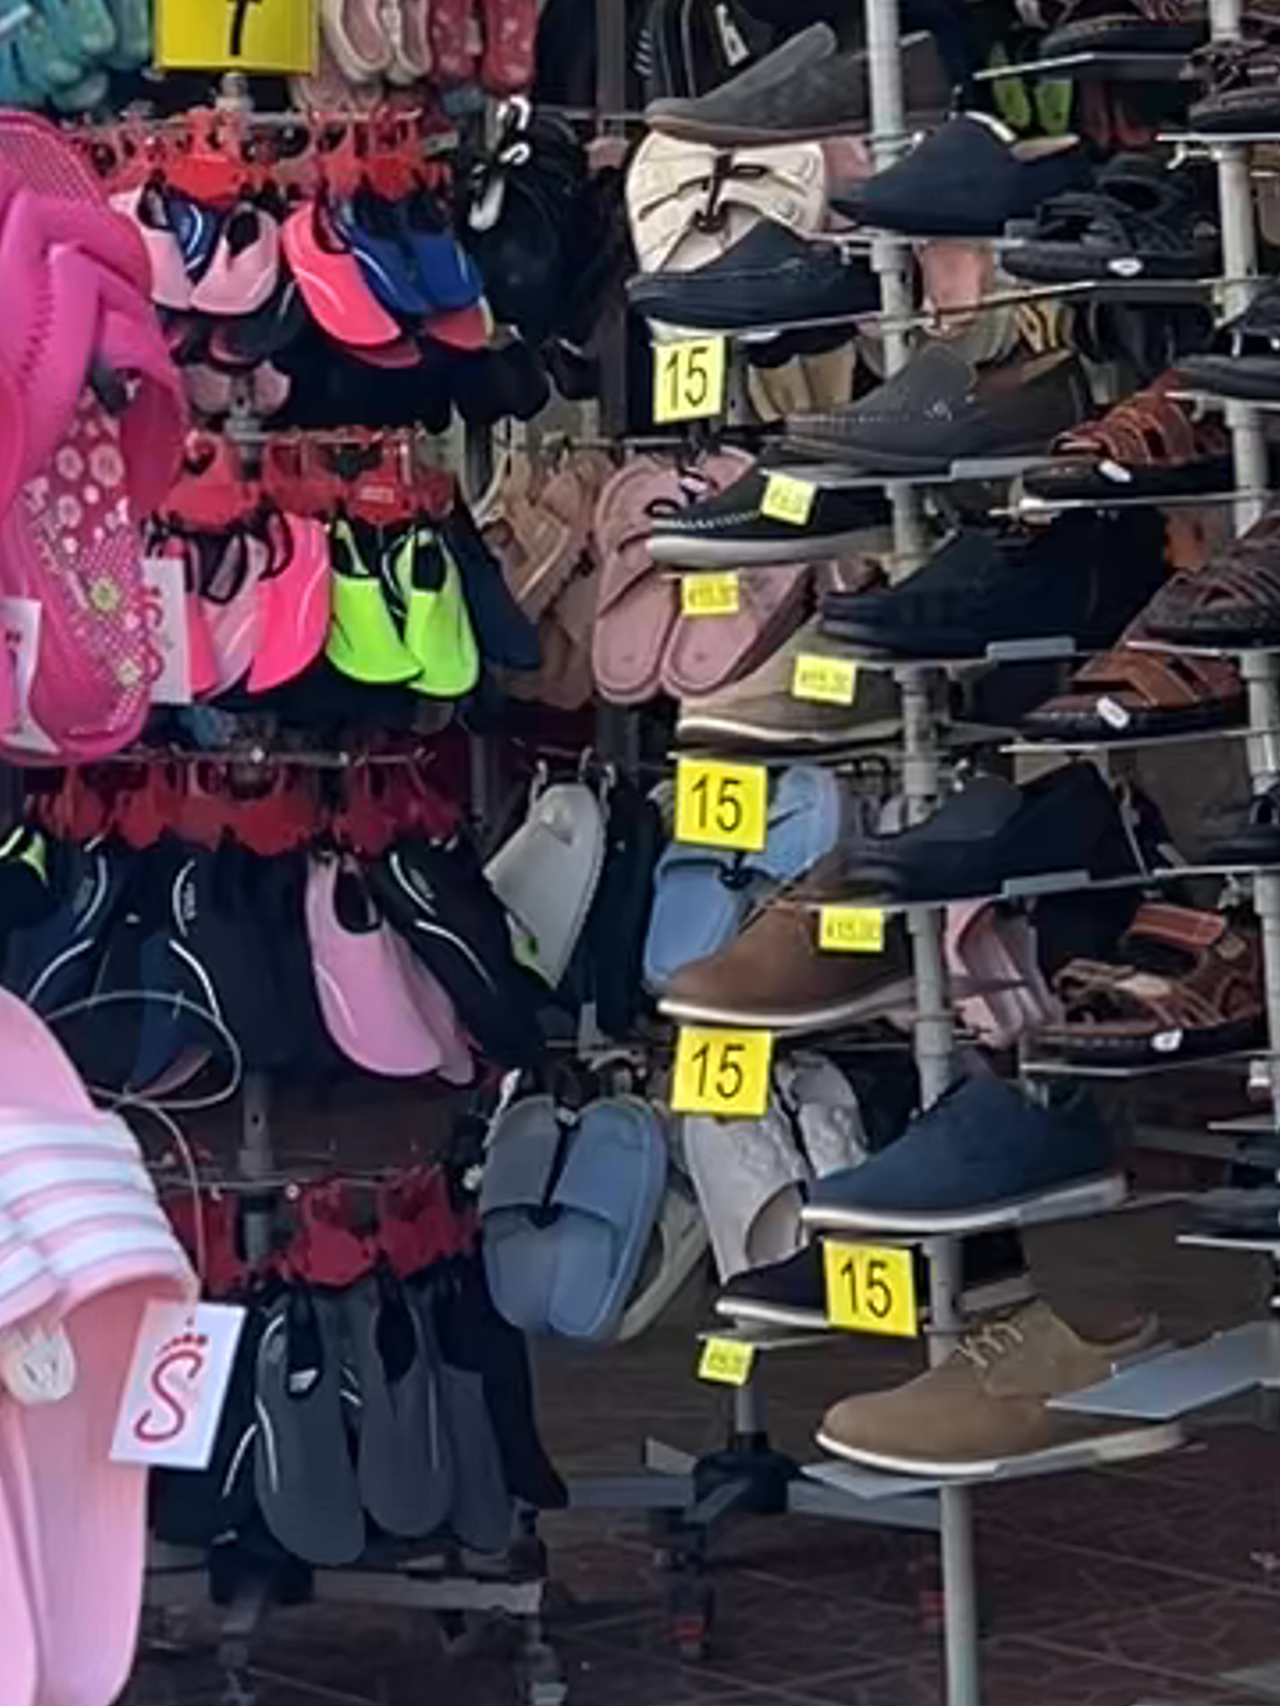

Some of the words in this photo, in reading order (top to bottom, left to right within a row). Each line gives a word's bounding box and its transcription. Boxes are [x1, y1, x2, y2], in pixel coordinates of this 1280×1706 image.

[666, 346, 709, 408] 15
[692, 775, 743, 833] 15
[692, 1042, 746, 1100] 15
[840, 1258, 893, 1319] 15
